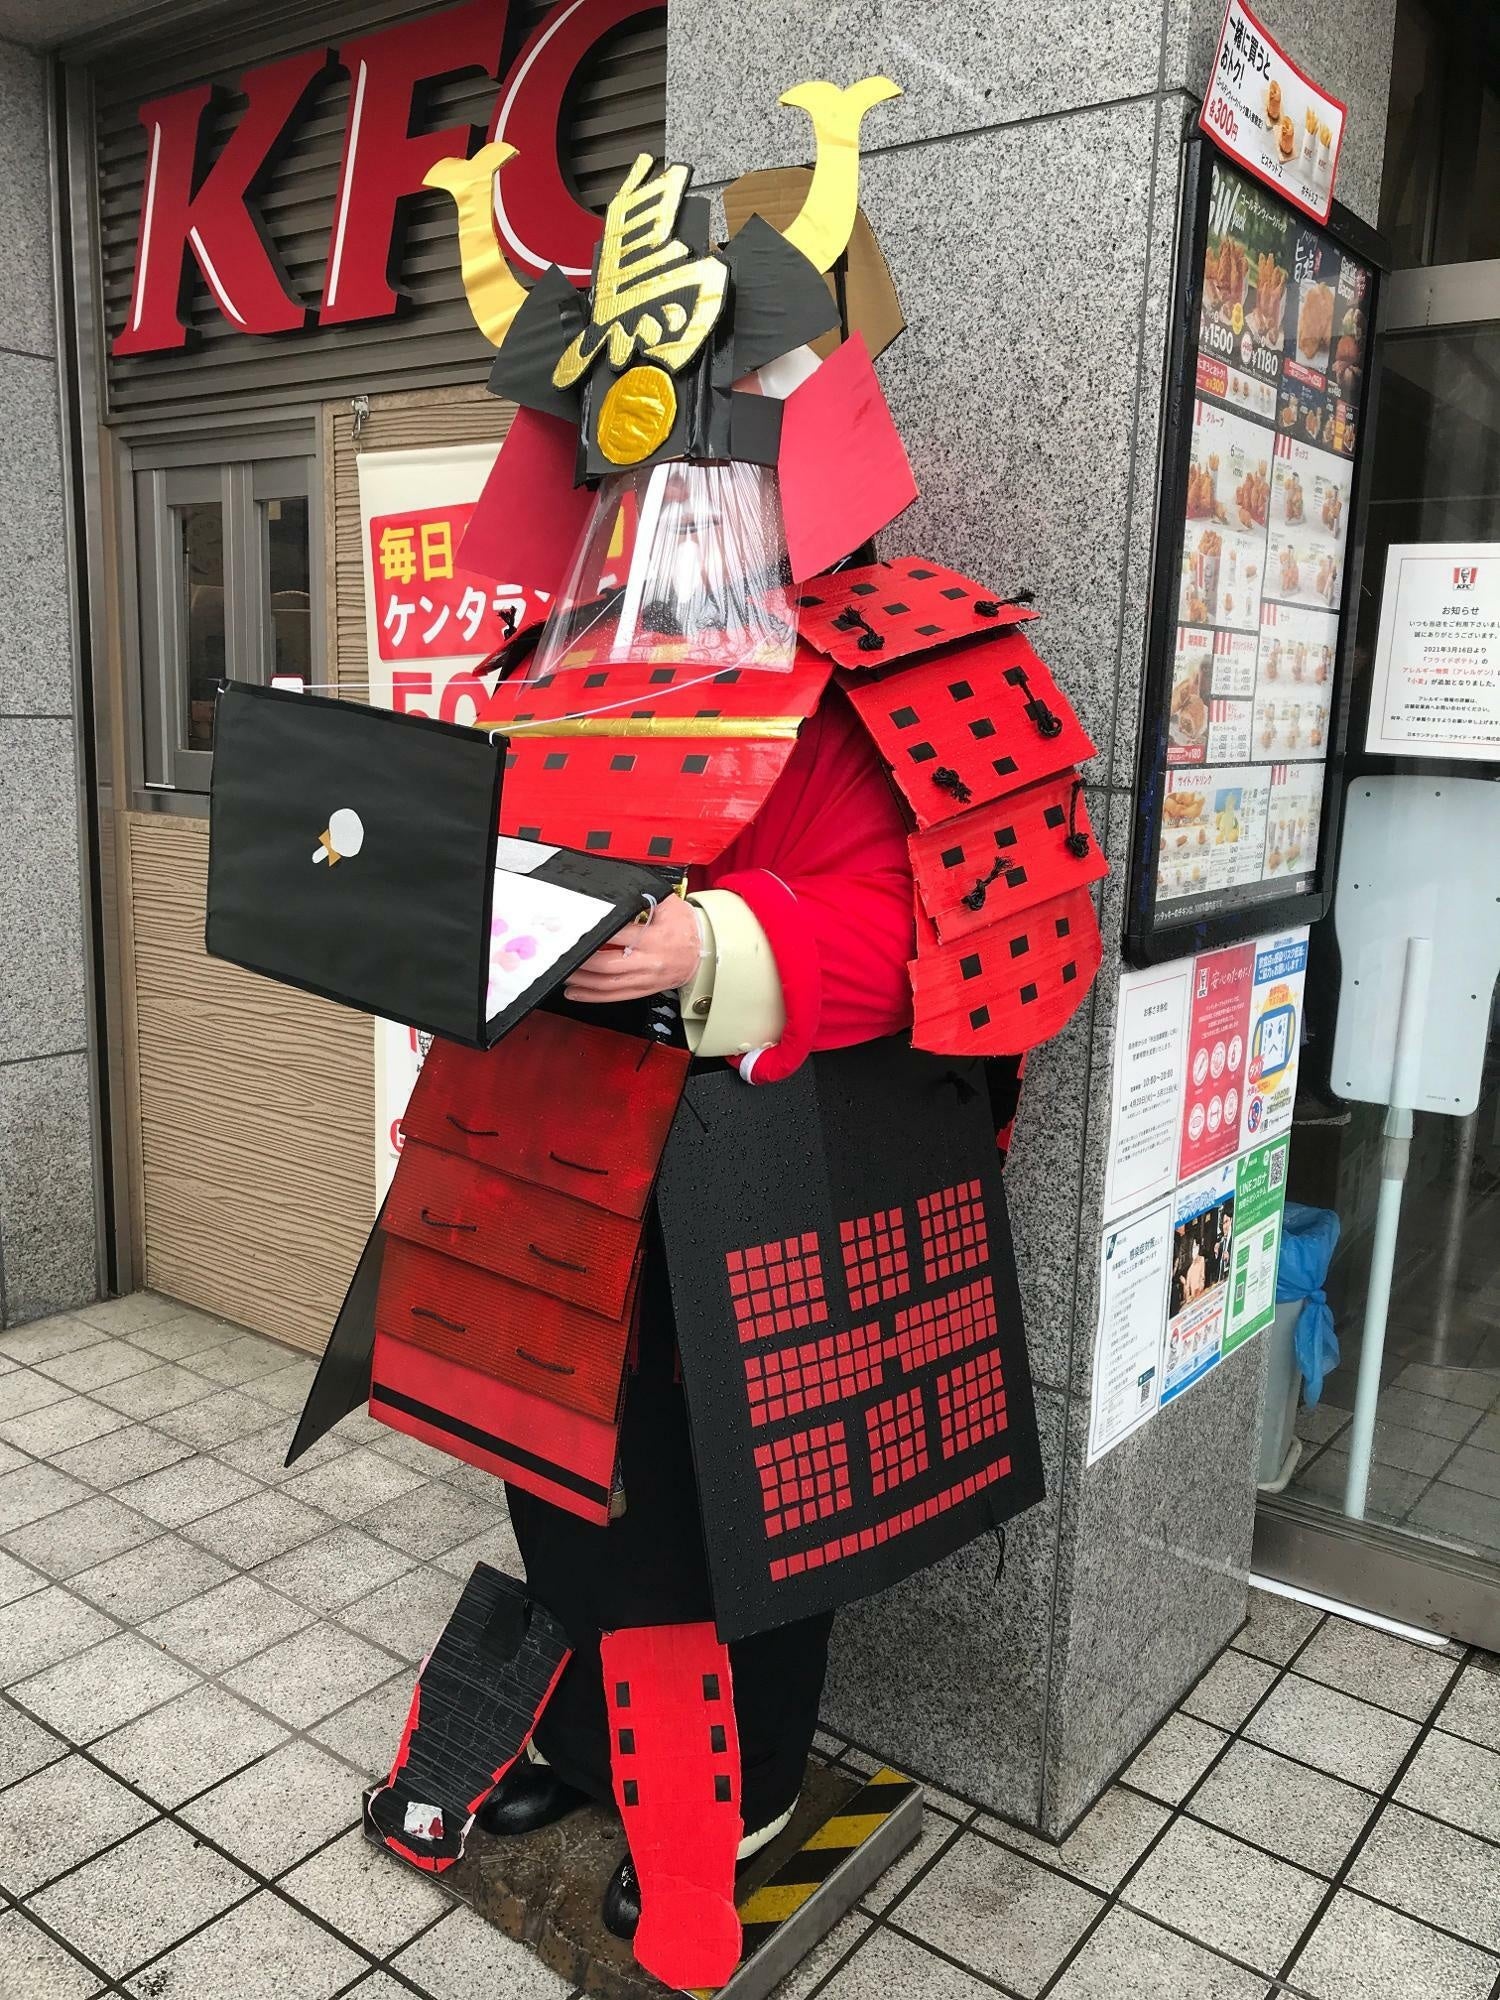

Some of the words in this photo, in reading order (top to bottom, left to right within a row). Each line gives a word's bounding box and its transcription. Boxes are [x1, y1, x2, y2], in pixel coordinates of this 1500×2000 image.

[1230, 16, 1270, 81] 一緒に買うと
[1209, 97, 1239, 142] 各300円
[112, 0, 667, 356] KFC
[1204, 323, 1233, 355] ¥1500
[1251, 347, 1278, 376] ¥1180
[1441, 606, 1480, 616] お知らせ
